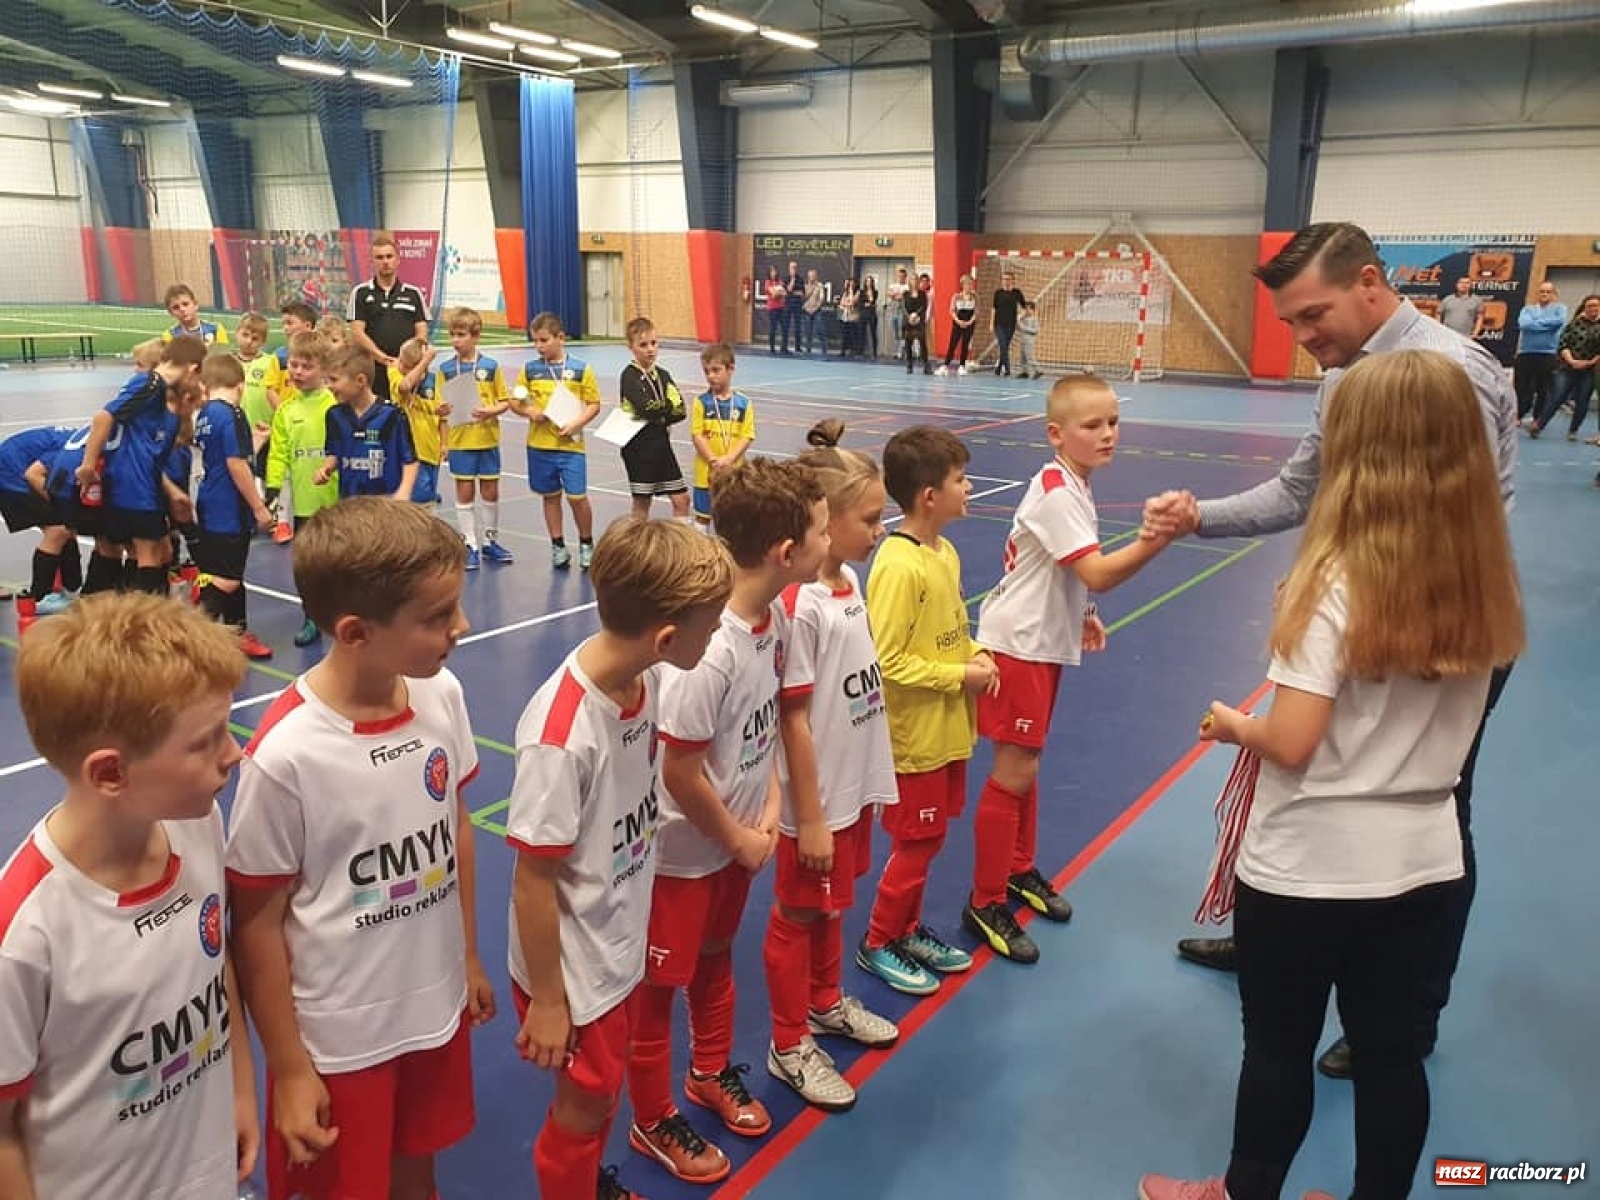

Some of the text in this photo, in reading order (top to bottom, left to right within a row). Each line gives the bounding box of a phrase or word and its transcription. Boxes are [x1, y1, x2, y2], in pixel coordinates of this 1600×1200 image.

[756, 236, 783, 249] LED
[354, 903, 411, 929] studio
[117, 1080, 184, 1122] studio
